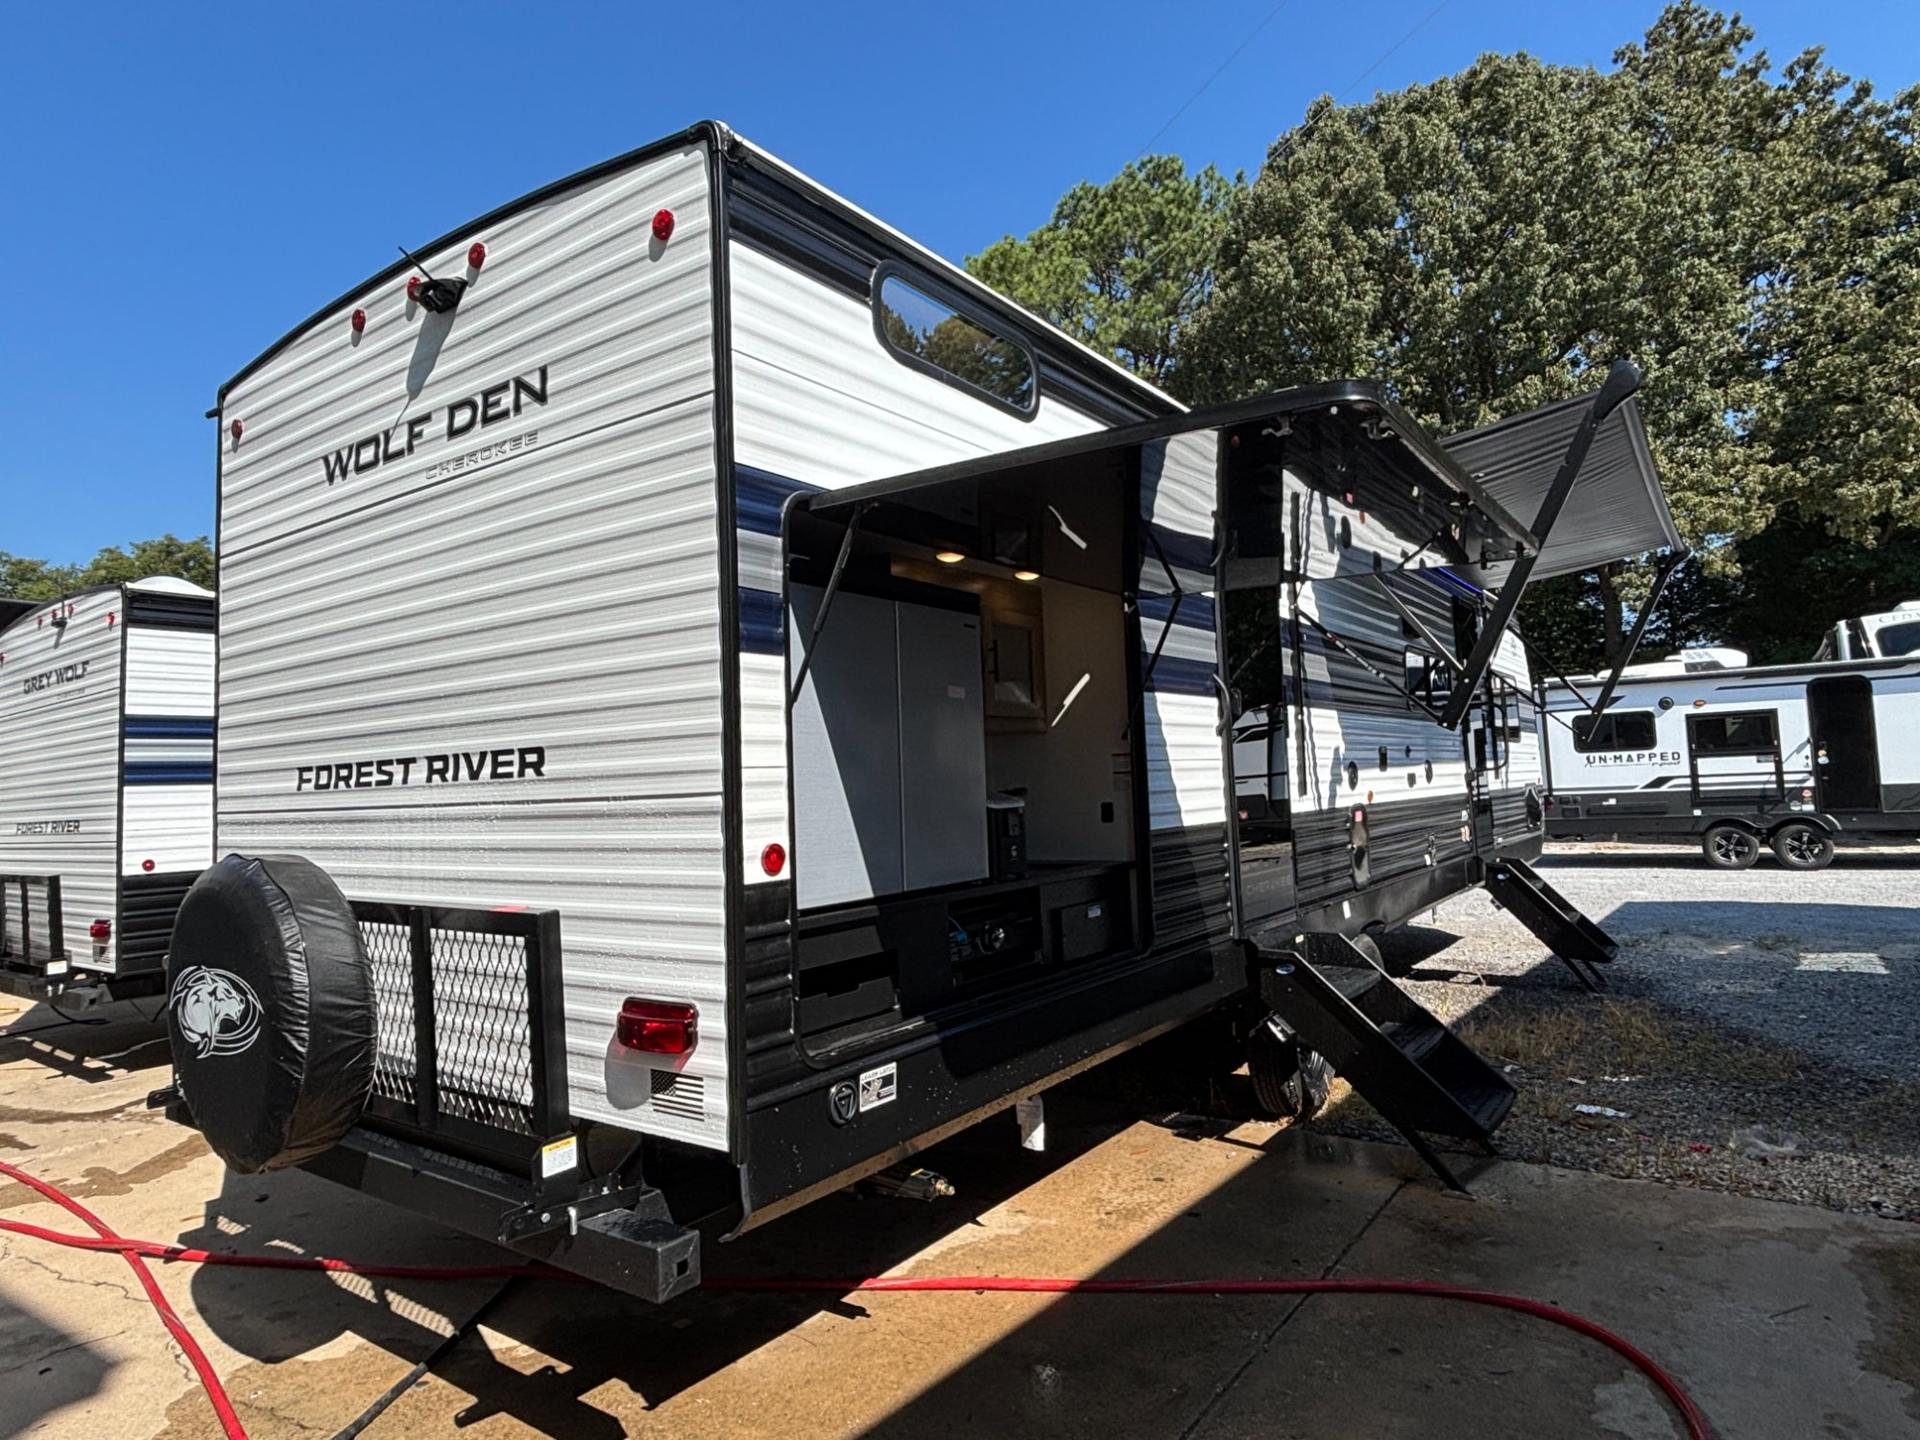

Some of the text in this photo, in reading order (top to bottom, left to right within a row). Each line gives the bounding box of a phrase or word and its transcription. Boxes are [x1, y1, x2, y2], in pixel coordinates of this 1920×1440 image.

[321, 364, 548, 486] WOLF DEN
[424, 429, 539, 480] CHEROKEE
[23, 670, 53, 694] GREY
[54, 660, 90, 684] WOLF
[296, 746, 545, 791] FOREST RIVER
[16, 820, 80, 836] FOREST RIVER
